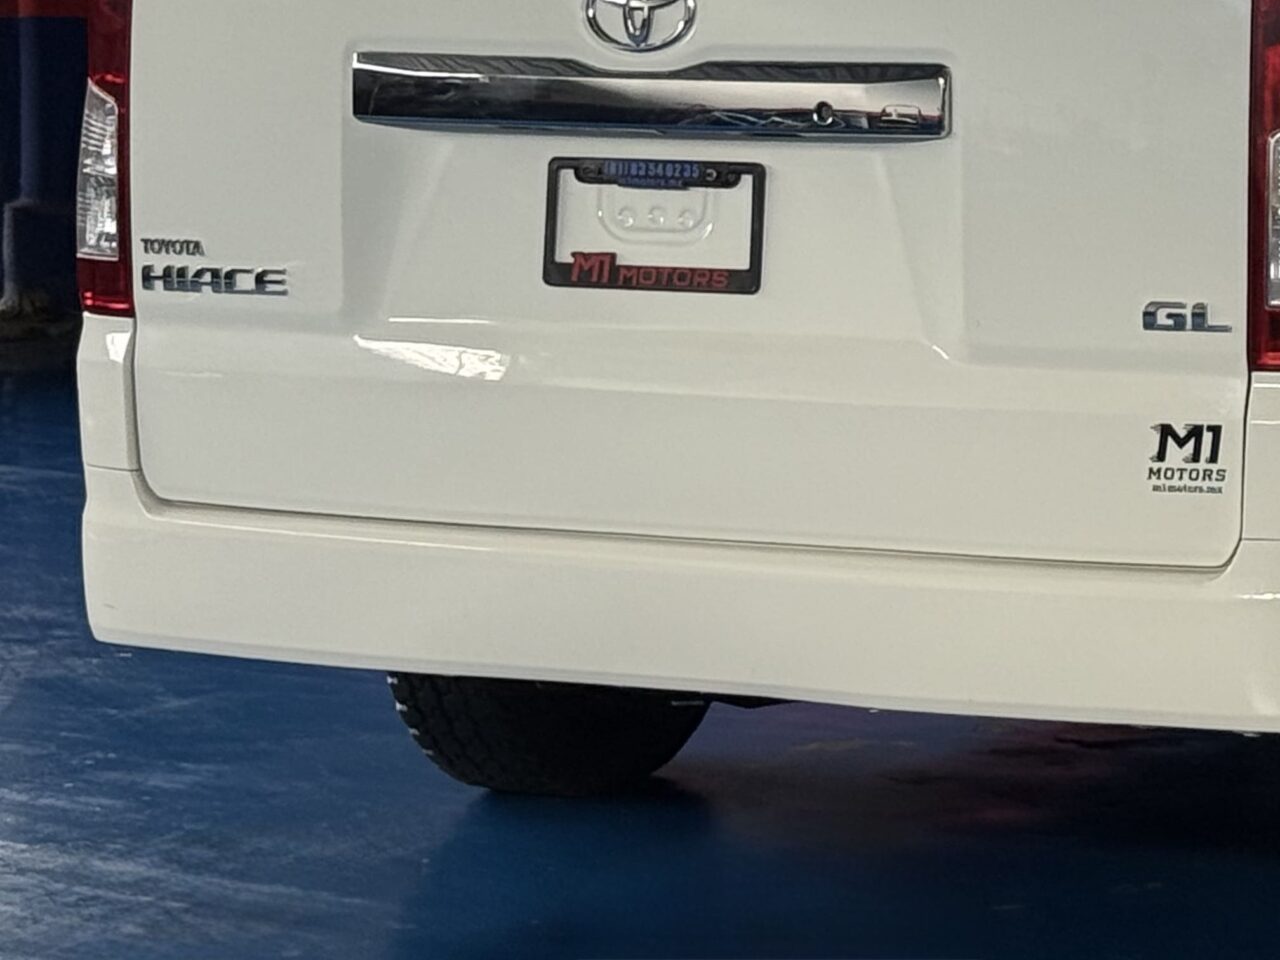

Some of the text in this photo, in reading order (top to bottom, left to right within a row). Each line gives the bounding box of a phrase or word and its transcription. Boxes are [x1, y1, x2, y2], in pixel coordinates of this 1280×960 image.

[139, 238, 206, 257] TOYOTA
[141, 264, 289, 296] HIACE
[570, 253, 730, 289] M1 MOTORS
[1142, 300, 1233, 333] GL
[1149, 422, 1223, 465] M1
[1146, 466, 1228, 482] MOTORS
